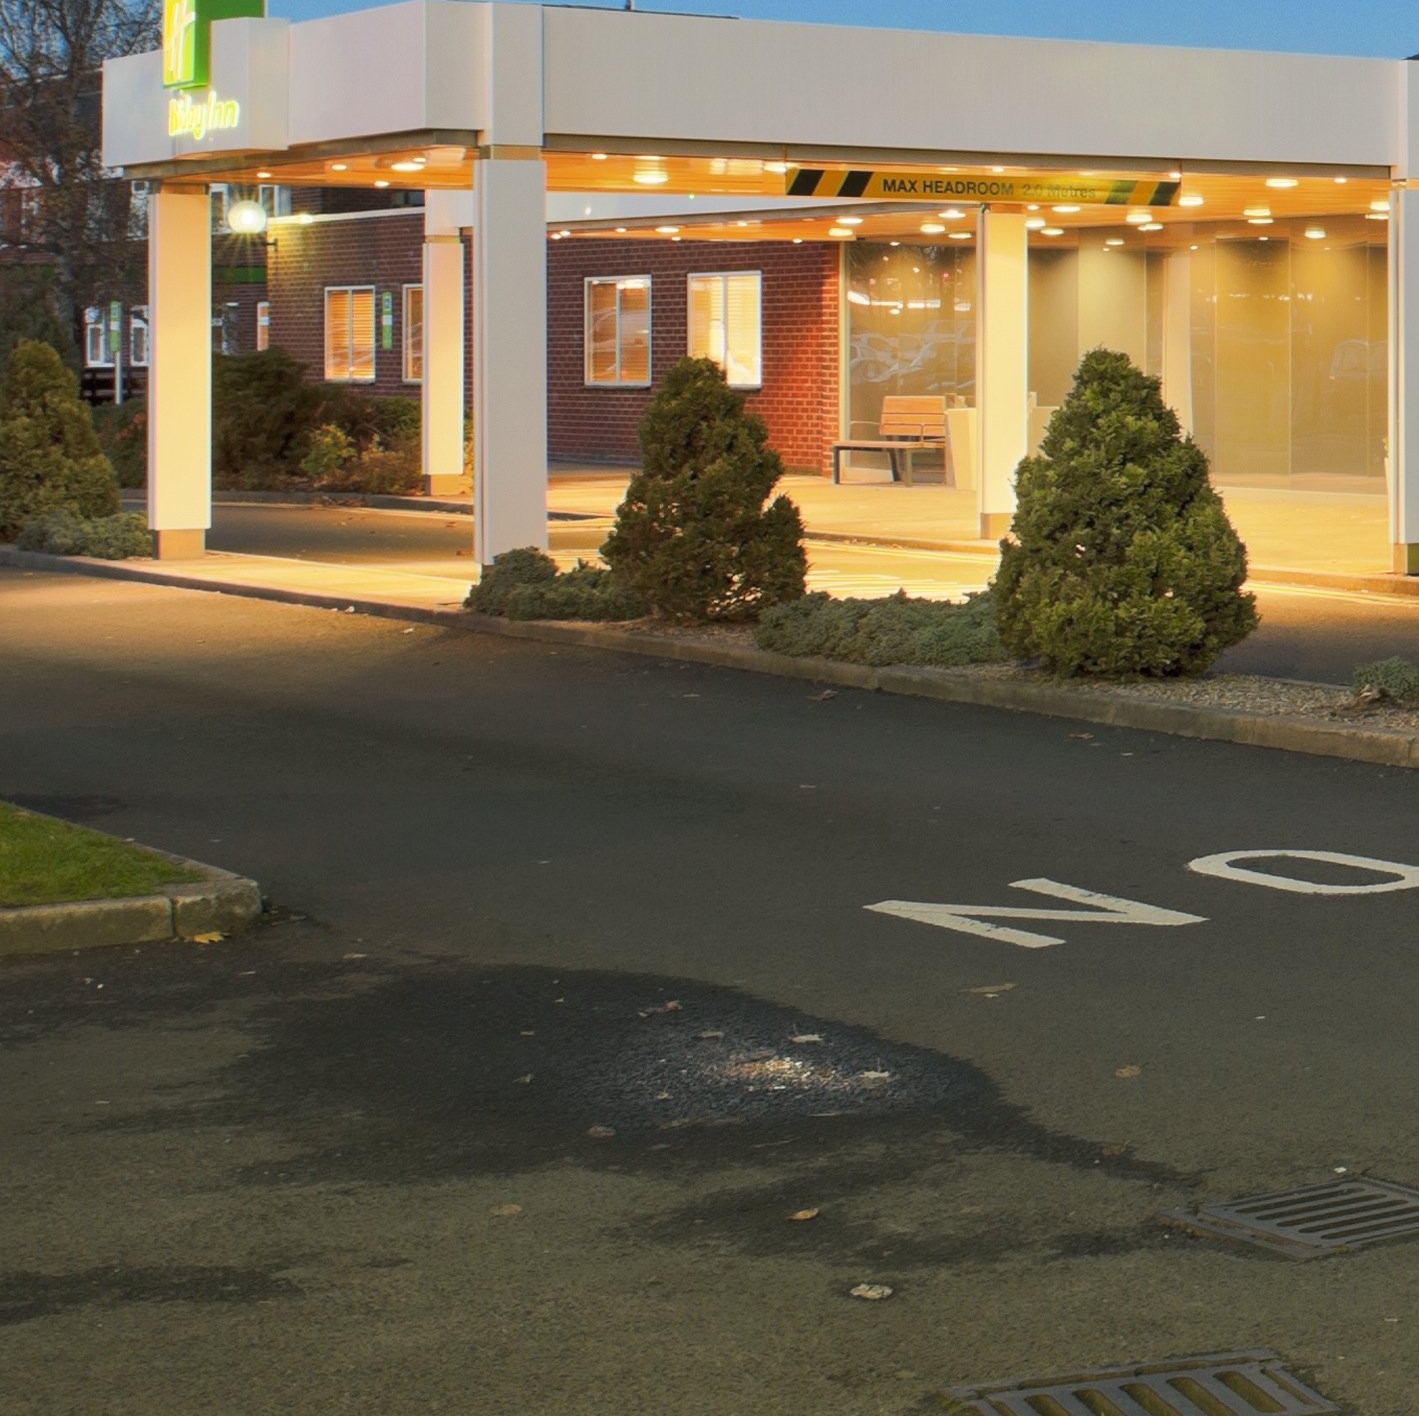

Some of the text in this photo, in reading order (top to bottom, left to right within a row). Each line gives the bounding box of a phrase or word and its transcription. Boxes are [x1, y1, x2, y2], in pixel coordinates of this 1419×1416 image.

[882, 178, 1097, 199] MAX HEADROOM 2.0 Metres
